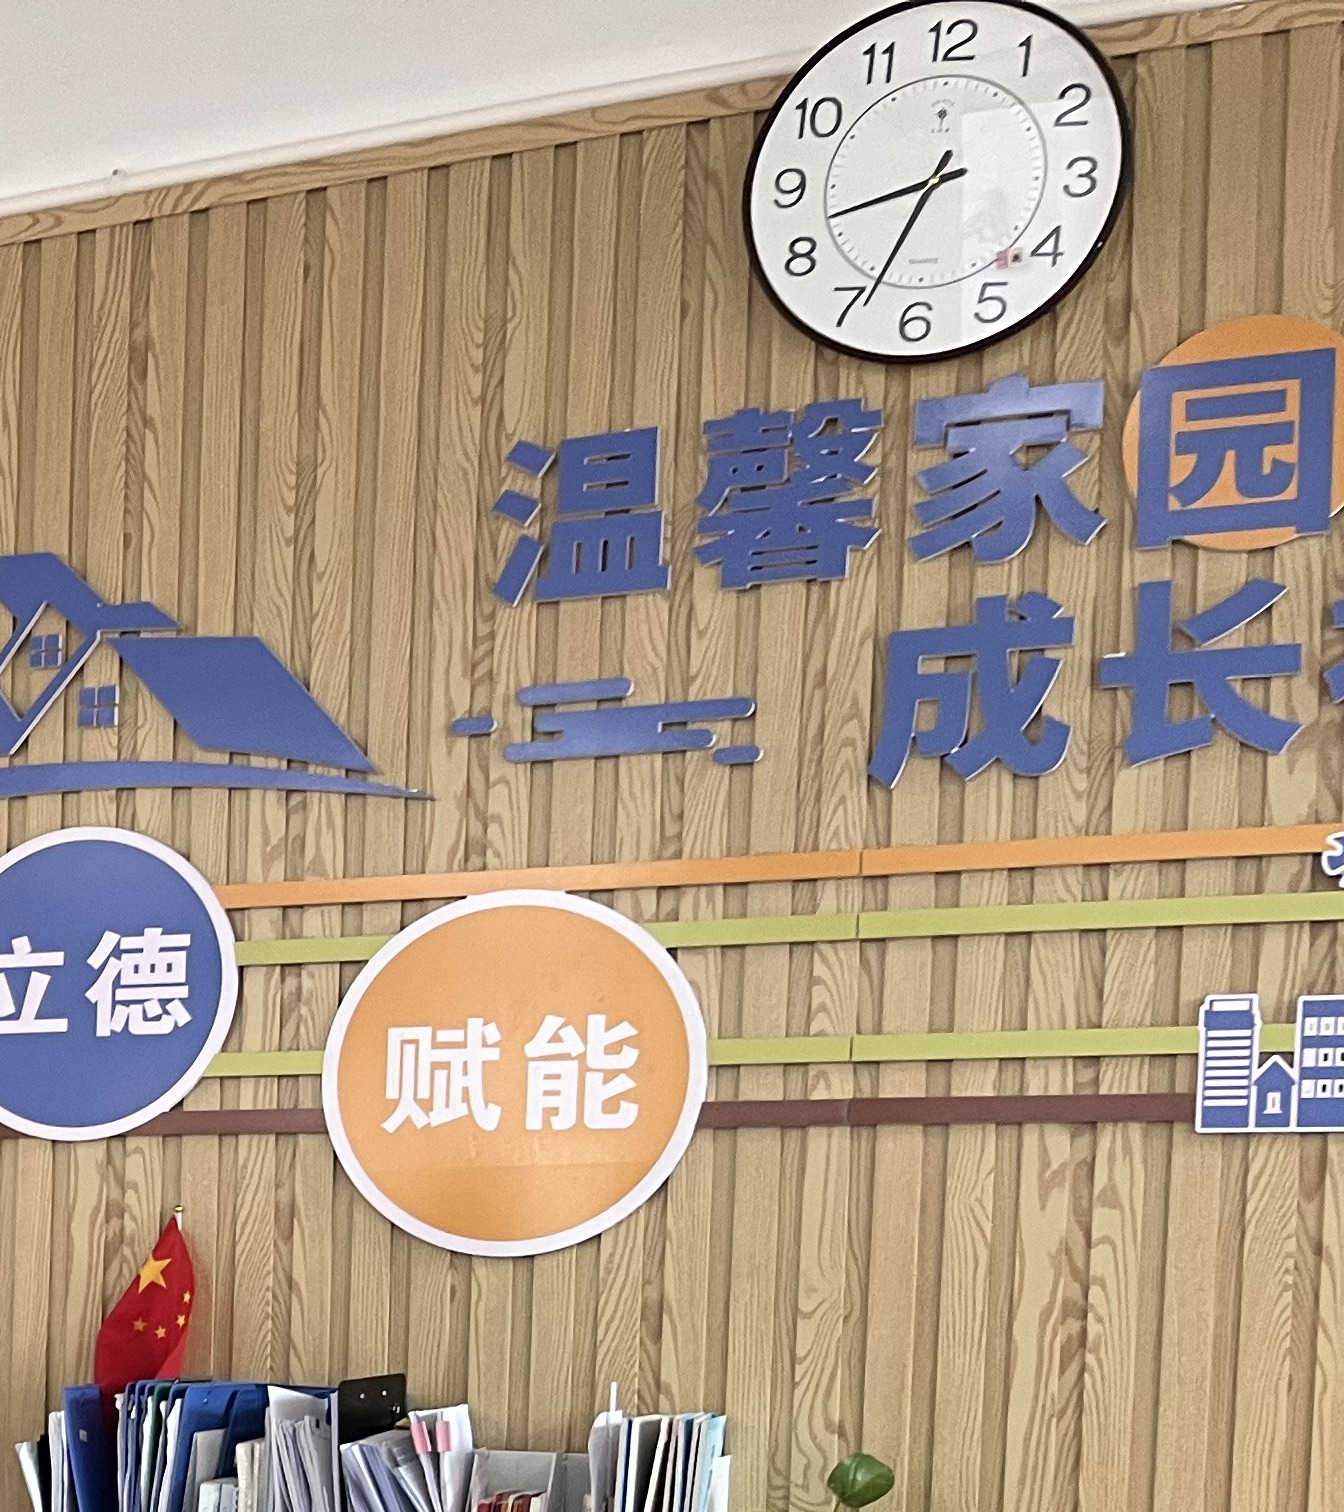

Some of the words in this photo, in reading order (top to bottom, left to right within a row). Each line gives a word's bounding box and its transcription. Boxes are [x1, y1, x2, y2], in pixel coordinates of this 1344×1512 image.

[928, 19, 979, 62] 12
[1018, 35, 1034, 77] 1
[862, 42, 896, 84] 11
[795, 97, 843, 139] 10
[1054, 83, 1092, 127] 2
[773, 168, 807, 209] 9
[1062, 156, 1099, 198] 3
[784, 236, 818, 277] 8
[1030, 225, 1064, 267] 4
[833, 285, 867, 328] 7
[898, 302, 933, 342] 6
[973, 281, 1009, 324] 5
[491, 348, 1338, 606] 温馨家园
[868, 578, 1344, 789] 成长
[382, 1012, 641, 1134] 赋能
